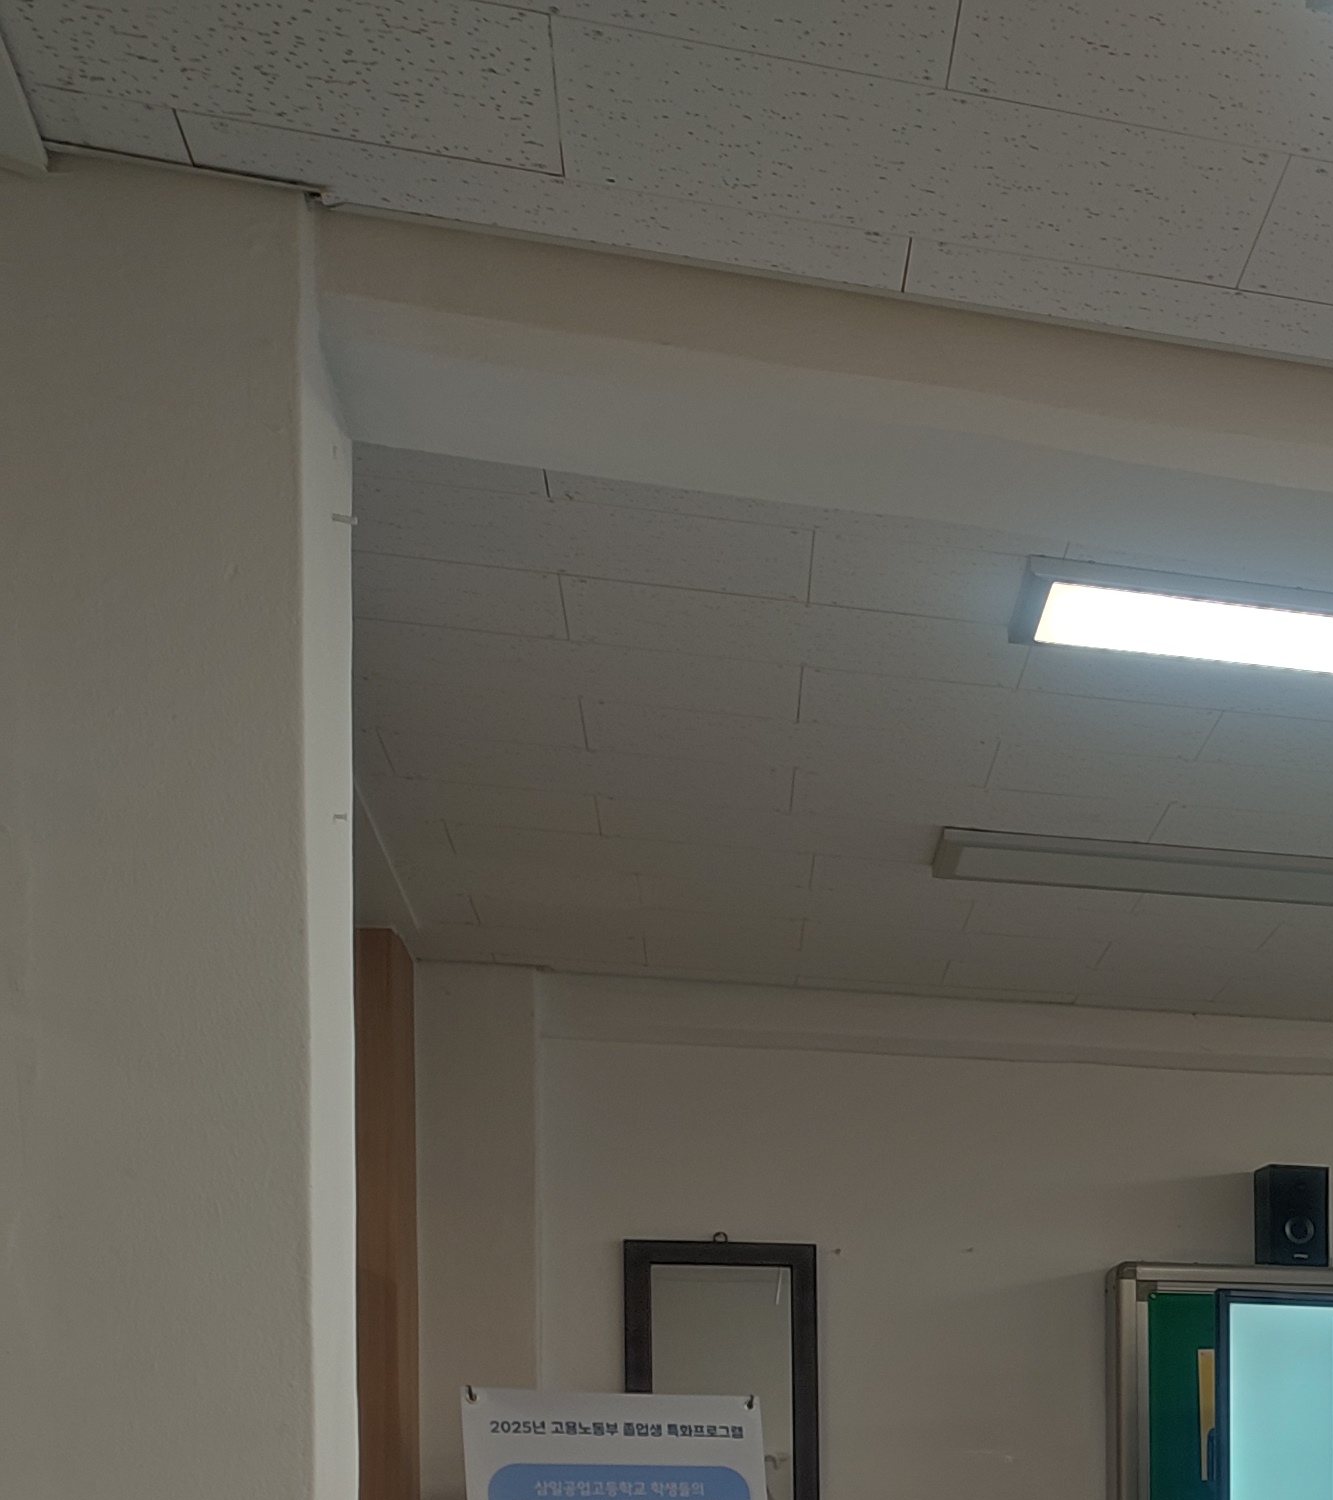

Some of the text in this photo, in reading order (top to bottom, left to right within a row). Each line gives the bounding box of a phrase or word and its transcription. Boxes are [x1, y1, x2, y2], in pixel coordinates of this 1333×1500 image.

[489, 1420, 547, 1435] 2025년
[551, 1421, 619, 1437] 고용노동부
[667, 1423, 744, 1439] 특화프로그램
[534, 1480, 705, 1498] 삼일공업고등학교 학생들의
